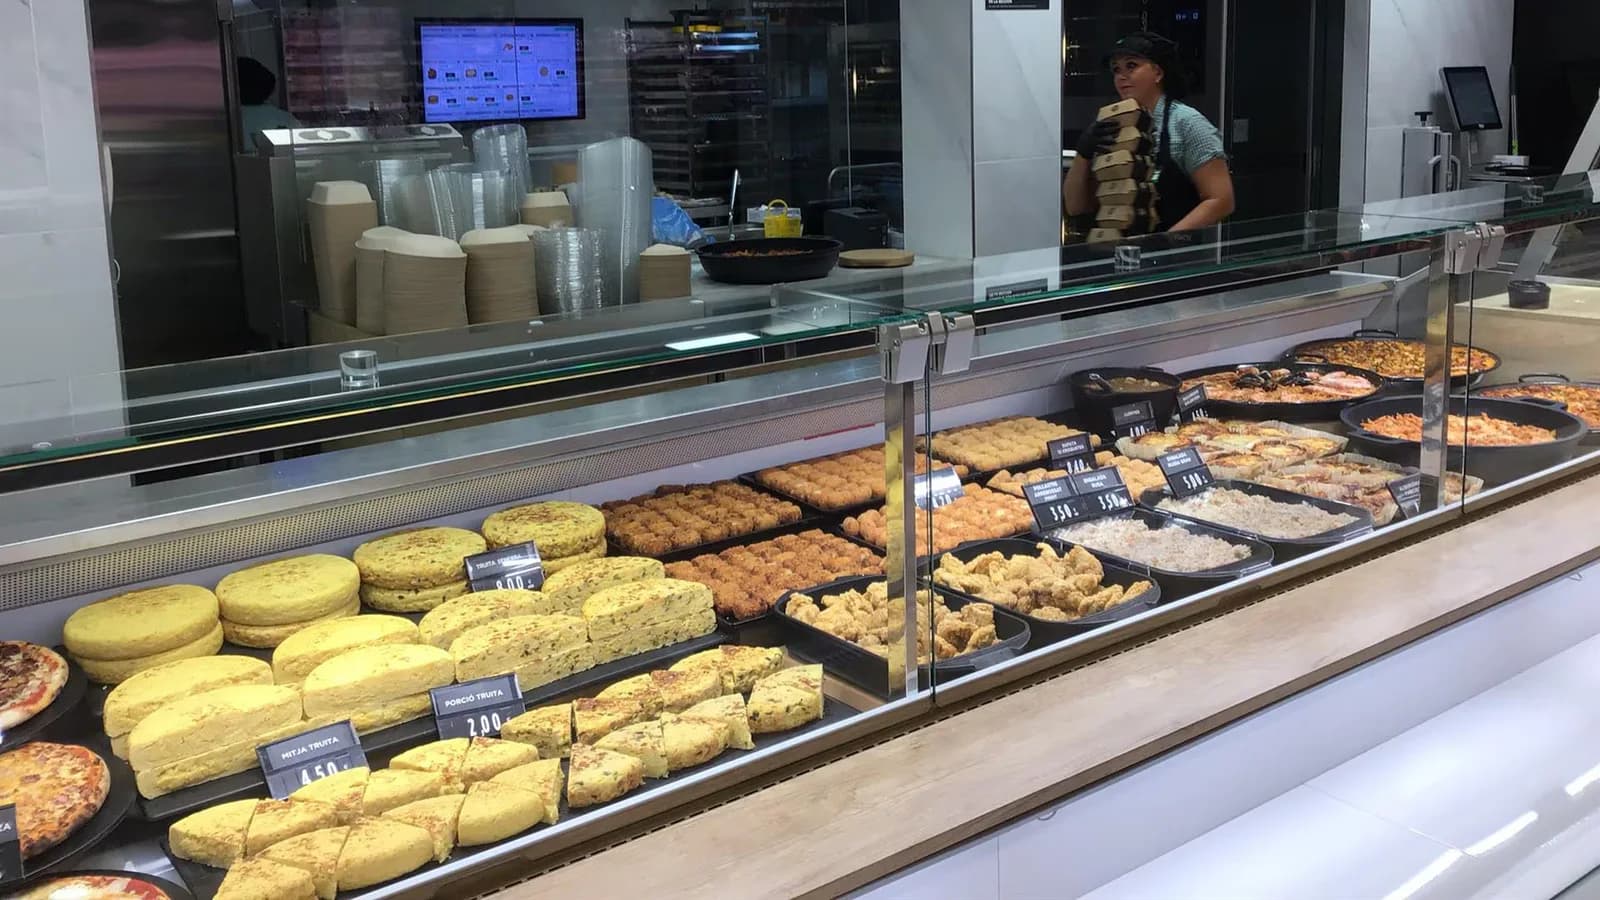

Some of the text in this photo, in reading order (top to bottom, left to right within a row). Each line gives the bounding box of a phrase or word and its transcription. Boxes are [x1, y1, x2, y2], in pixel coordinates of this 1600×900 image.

[476, 560, 496, 570] TRUITA
[444, 688, 504, 708] PORCIÓ TRUITA
[467, 712, 501, 737] 2,00
[281, 736, 340, 760] MITJA TRUITA
